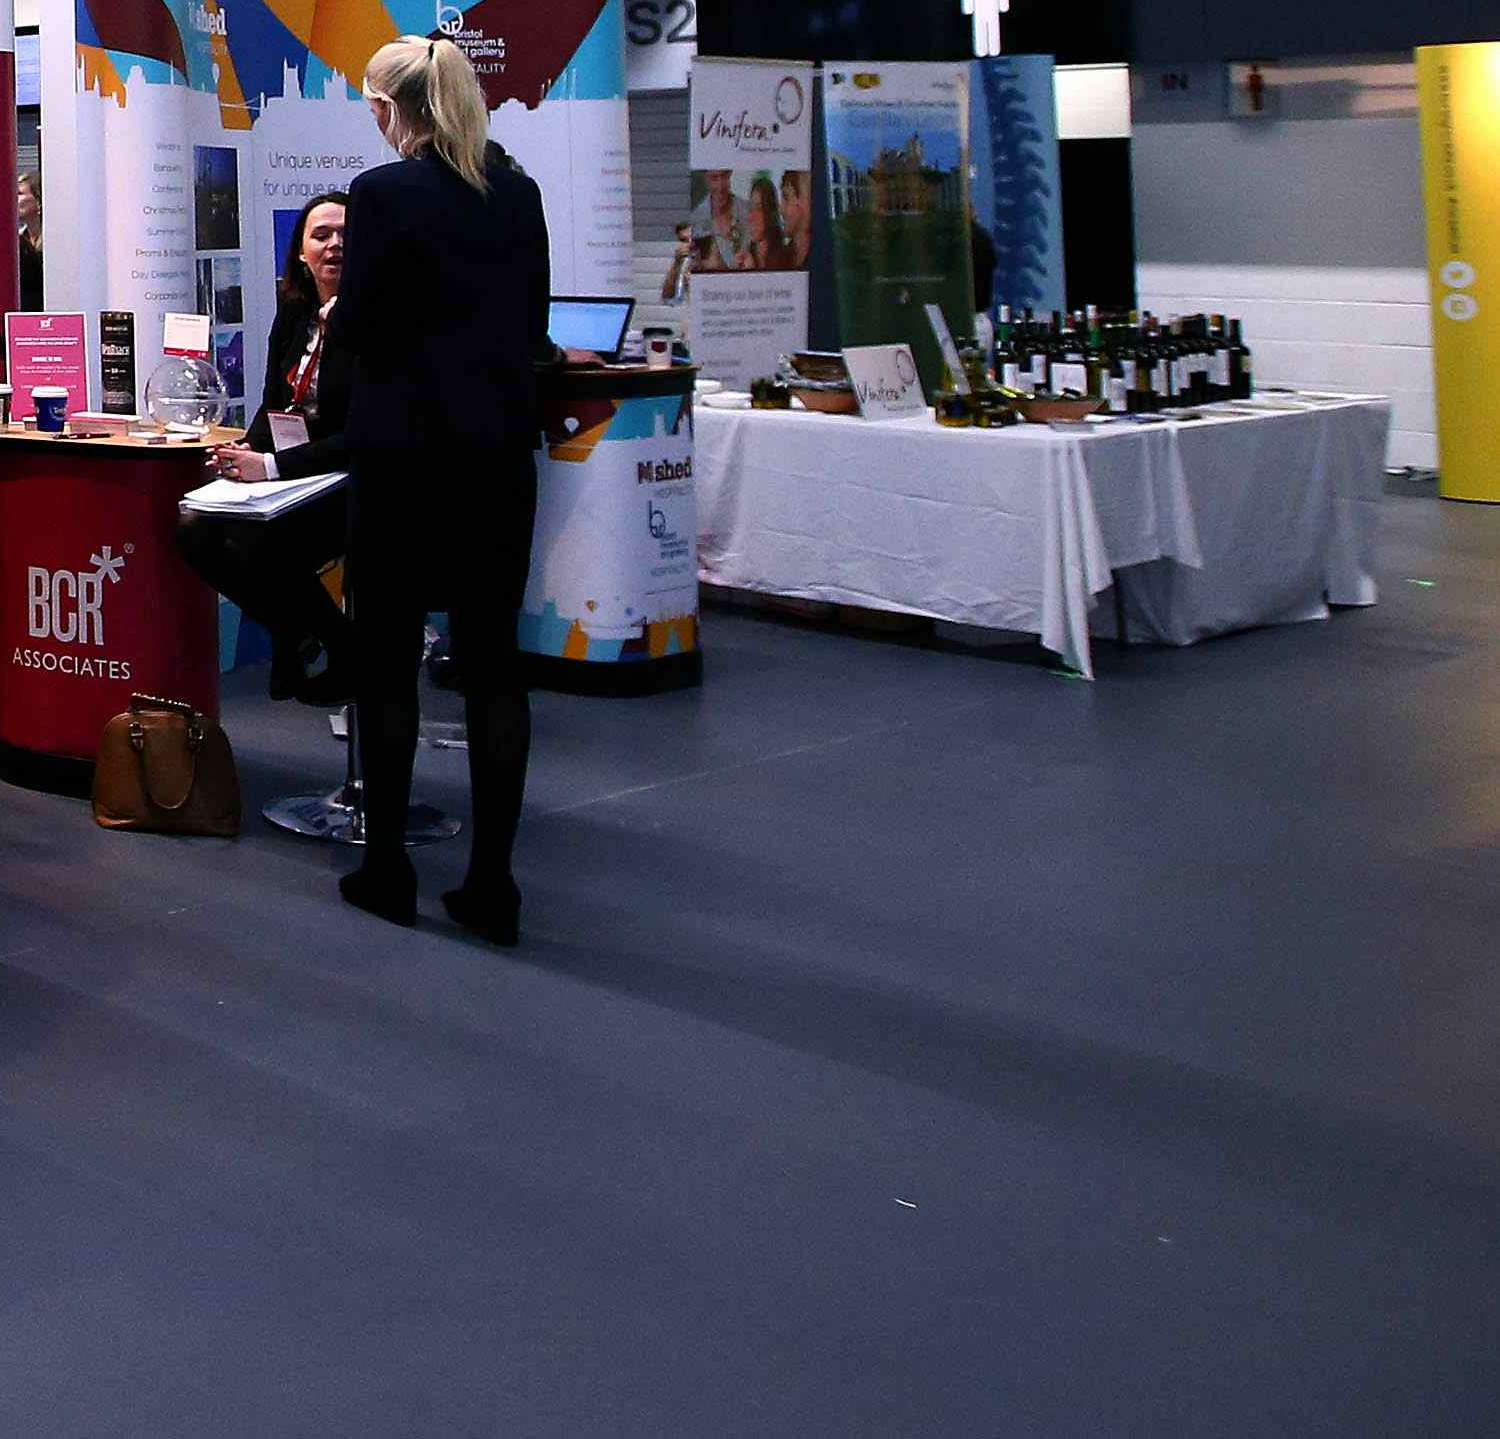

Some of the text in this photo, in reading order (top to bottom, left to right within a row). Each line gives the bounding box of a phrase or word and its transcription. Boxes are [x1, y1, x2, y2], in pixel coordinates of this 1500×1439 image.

[455, 28, 483, 39] bristol
[454, 38, 497, 47] museum
[468, 46, 506, 59] gallery
[268, 152, 364, 171] Unique venues
[263, 182, 326, 198] for unique
[655, 456, 693, 482] shed
[28, 566, 105, 646] BCR
[12, 647, 131, 680] ASSOCIATES
